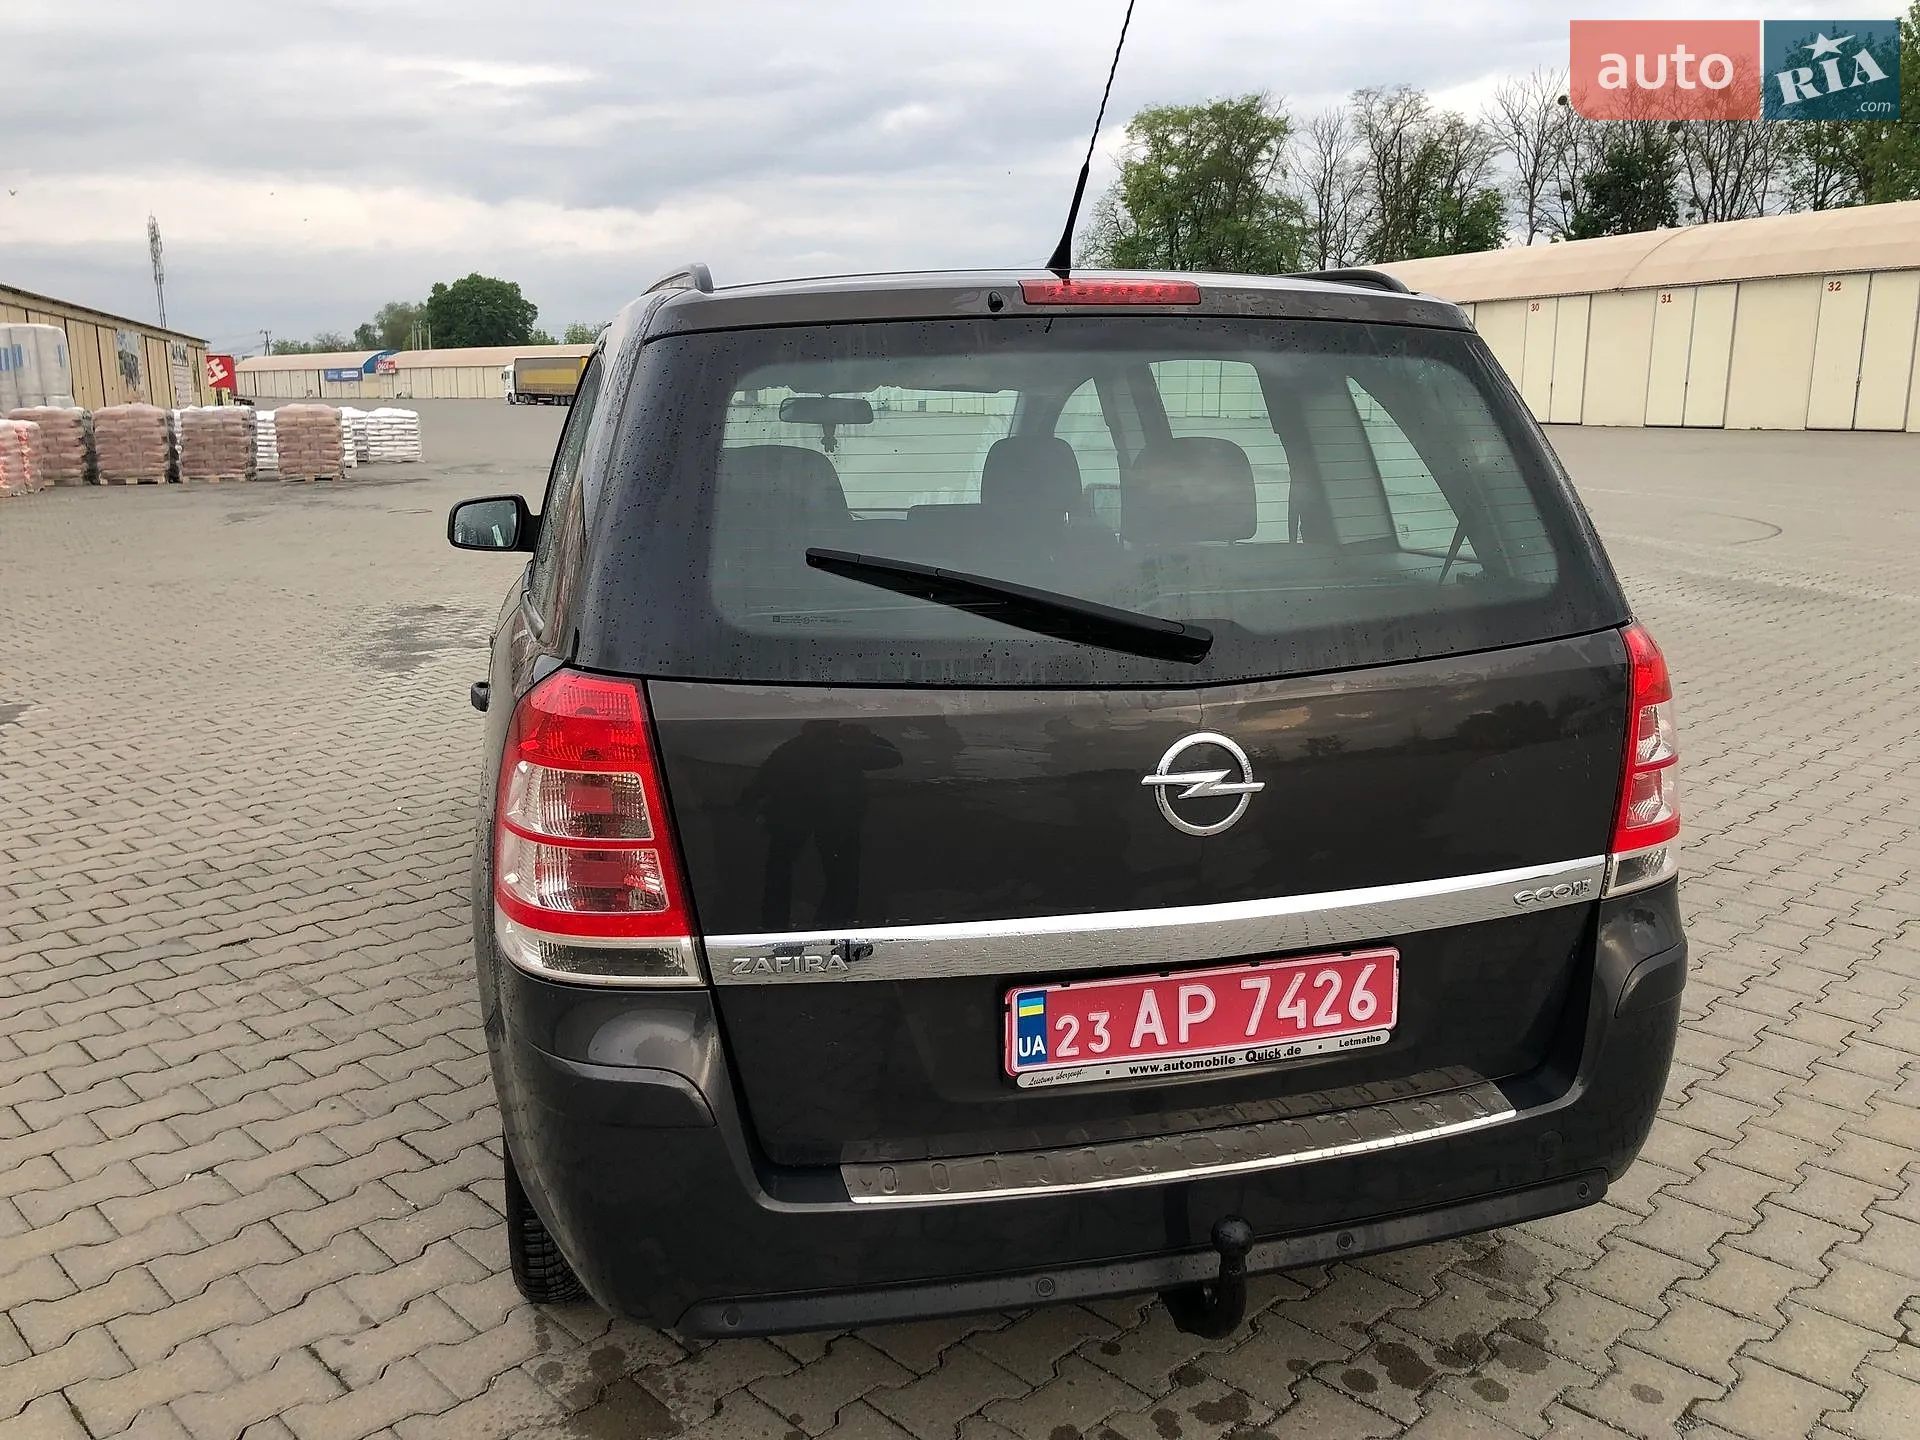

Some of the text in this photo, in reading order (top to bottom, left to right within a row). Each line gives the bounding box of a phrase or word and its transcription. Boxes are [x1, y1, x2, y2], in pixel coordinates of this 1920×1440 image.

[1827, 280, 1842, 292] 32
[1660, 293, 1672, 304] 31
[1530, 303, 1540, 312] 30
[732, 954, 849, 975] ZAFIRA
[1055, 963, 1378, 1058] 23 AP 7426
[1018, 1034, 1046, 1057] UA
[1339, 1034, 1382, 1048] Letmathe
[1128, 1055, 1236, 1075] www.automobile
